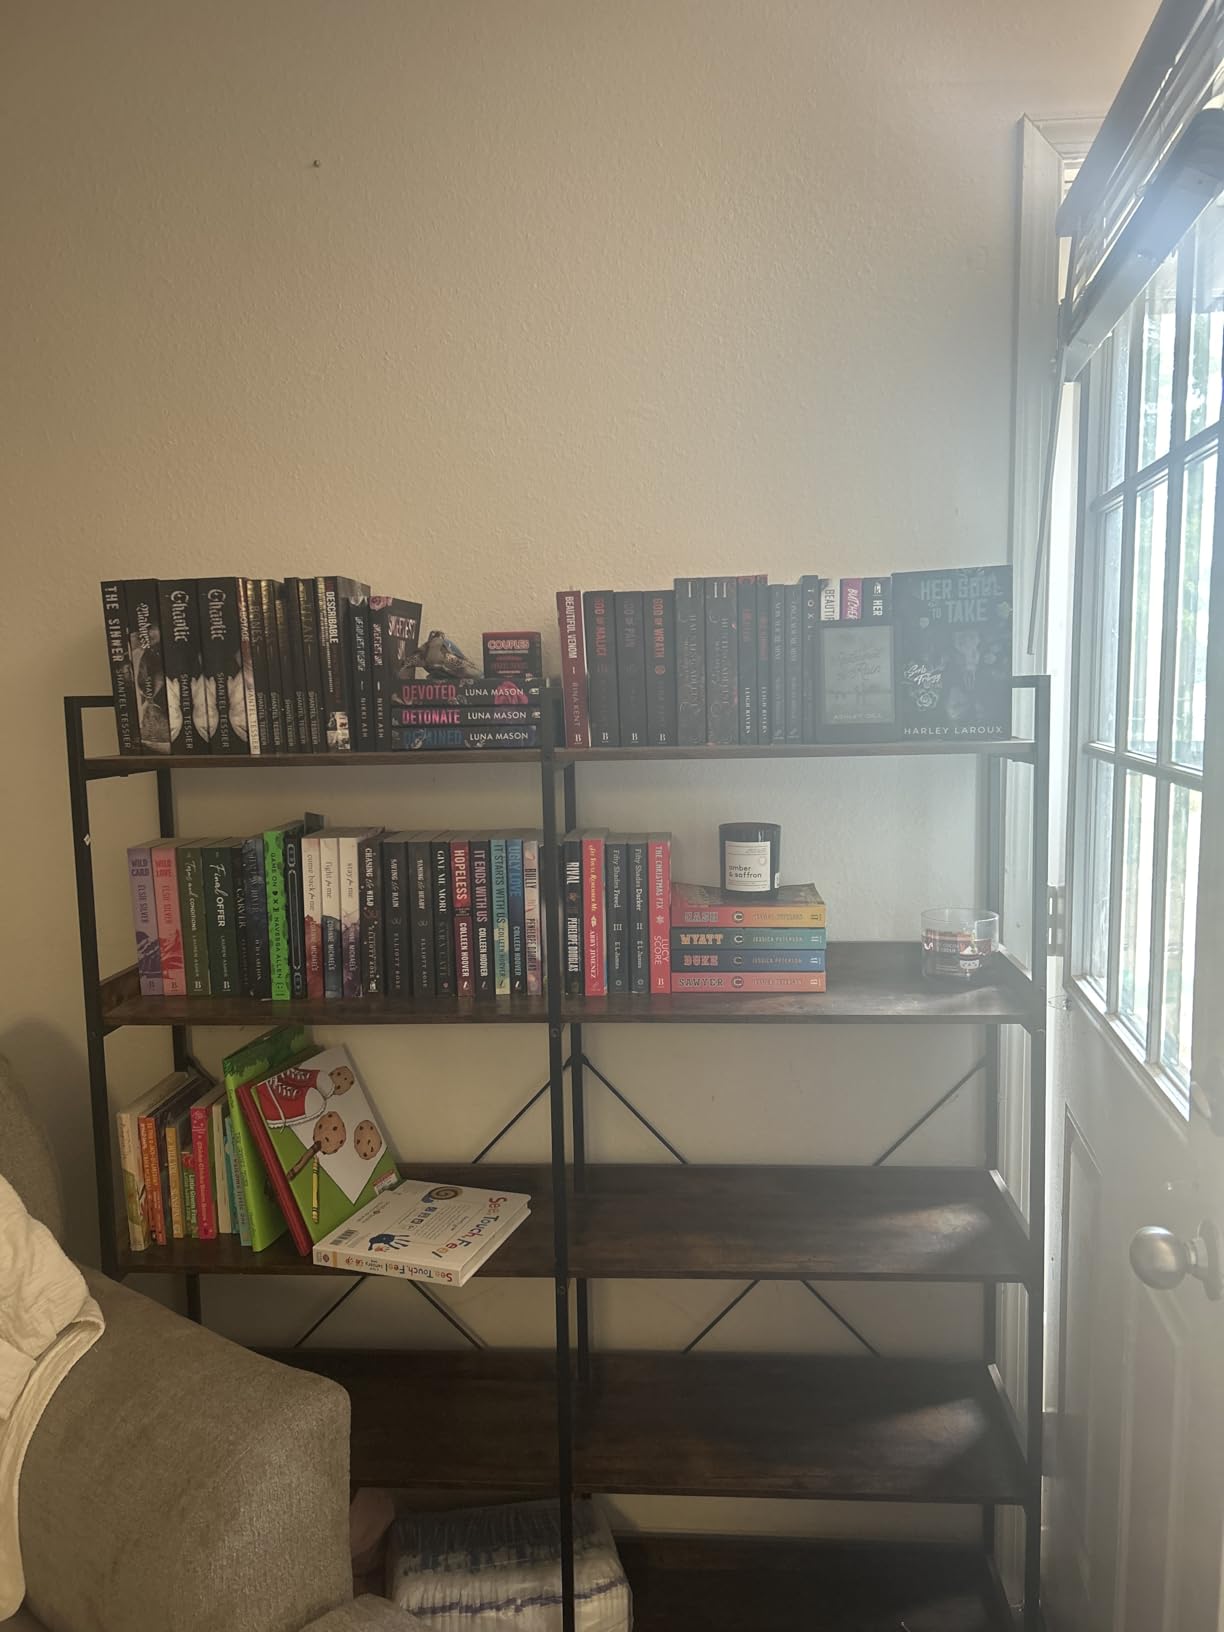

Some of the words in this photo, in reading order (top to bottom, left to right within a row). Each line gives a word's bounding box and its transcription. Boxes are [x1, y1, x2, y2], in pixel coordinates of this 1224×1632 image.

[105, 586, 119, 610] THE
[921, 580, 952, 600] HER
[565, 597, 576, 633] BEAUTIFUL
[594, 599, 605, 614] GOD
[653, 599, 663, 616] GOD
[873, 600, 882, 616] HER
[946, 599, 988, 623] TAKE
[136, 602, 151, 649] Madness
[107, 619, 123, 663] SINNER
[488, 640, 529, 649] COUPLES
[567, 634, 577, 658] VENOM
[625, 627, 636, 647] PAIN
[654, 628, 664, 658] WRATH
[181, 674, 190, 711] SHANTEL
[217, 672, 227, 709] SHANTEL
[402, 685, 456, 699] DEVOTED
[465, 688, 488, 696] LUNA
[491, 688, 524, 696] MASON
[116, 669, 125, 708] SHANTEL
[121, 713, 131, 748] TESSIER
[402, 709, 460, 724] DETONATE
[468, 712, 491, 720] LUNA
[494, 711, 526, 719] MASON
[572, 705, 580, 727] KENT
[184, 715, 193, 749] TESSIER
[221, 713, 229, 748] TESSIER
[250, 720, 259, 751] TESSIER
[470, 733, 493, 741] LUNA
[496, 732, 528, 740] MASON
[904, 727, 949, 735] HARLEY
[955, 726, 1002, 734] LAROUX
[474, 850, 485, 859] IT
[494, 844, 504, 854] IT
[634, 849, 642, 863] Fifty
[655, 845, 663, 858] THE
[307, 854, 315, 873] come
[325, 861, 333, 879] fight
[365, 848, 373, 877] CHASING
[437, 850, 445, 871] GIVE
[494, 855, 505, 885] STARTS
[508, 847, 520, 873] UGLY
[209, 864, 227, 896] Final
[345, 863, 353, 878] stay
[454, 850, 467, 900] HOPELESS
[474, 861, 486, 884] ENDS
[525, 869, 536, 889] BULLY
[566, 862, 580, 884] RIVAL
[735, 871, 762, 879] saffron
[188, 883, 198, 897] and
[271, 875, 278, 887] ON
[308, 874, 316, 892] back
[510, 874, 521, 897] LOVE
[138, 885, 146, 900] ELSIE
[162, 885, 170, 901] ELSIE
[326, 888, 333, 898] me
[348, 888, 354, 898] me
[392, 892, 400, 908] RAIN
[438, 889, 447, 914] MORE
[475, 886, 487, 908] WITH
[496, 888, 505, 910] WITH
[635, 889, 643, 911] Darker
[139, 903, 148, 923] SILVER
[216, 897, 225, 927] OFFER
[656, 898, 664, 909] FIX
[163, 904, 172, 924] SILVER
[476, 911, 488, 922] US
[496, 912, 506, 923] US
[459, 922, 468, 950] COLLEEN
[478, 928, 486, 953] COLLEEN
[527, 919, 535, 944] PENELOPE
[567, 918, 578, 944] PENELOPE
[680, 934, 723, 944] WYATT
[568, 946, 578, 972] DOUGLAS
[654, 936, 662, 965] SCORE
[661, 939, 669, 962] LUCY
[684, 955, 718, 966] DUKE
[461, 952, 469, 977] HOOVER
[479, 954, 488, 977] HOOVER
[680, 978, 723, 987] SAWYER
[432, 1239, 472, 1258] Feel
[385, 1263, 405, 1274] Feel
